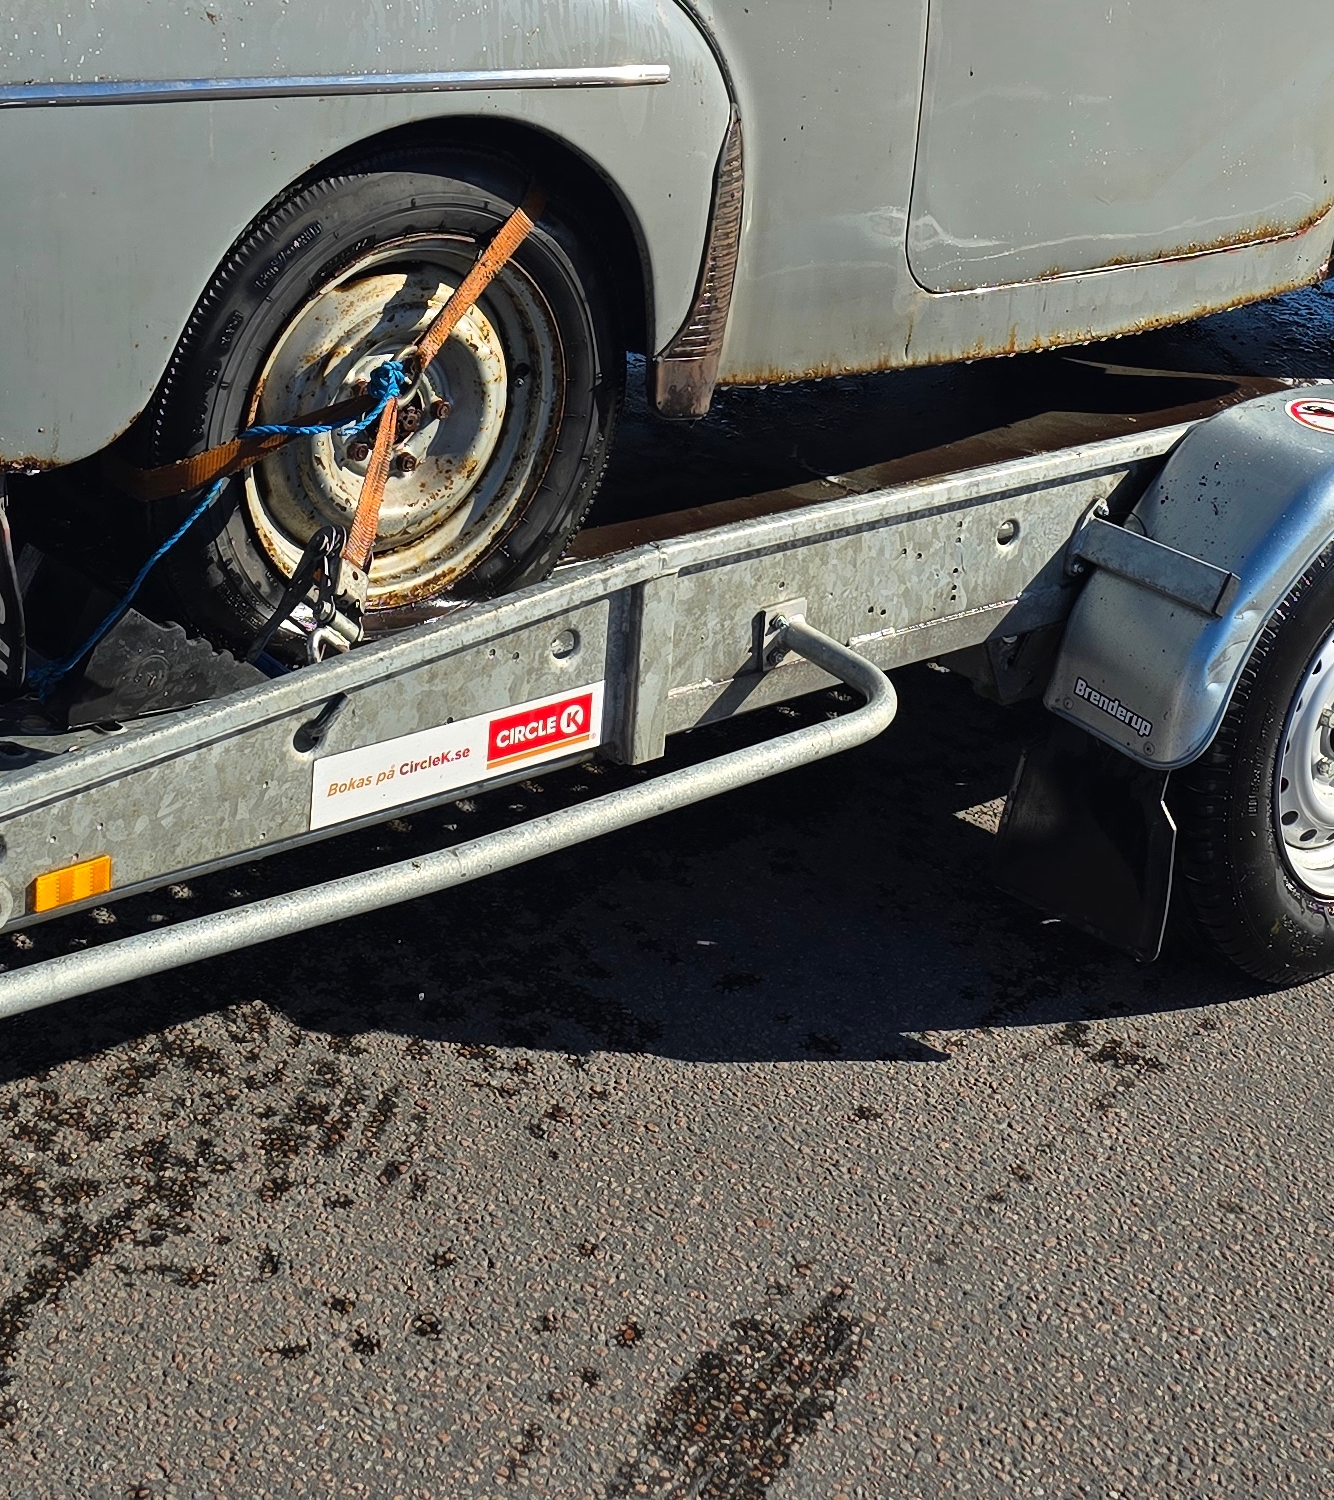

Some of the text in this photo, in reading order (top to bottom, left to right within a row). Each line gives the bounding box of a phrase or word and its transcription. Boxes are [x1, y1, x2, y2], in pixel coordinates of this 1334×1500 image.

[495, 714, 557, 748] CIRCLE
[1074, 678, 1152, 736] Brenderup
[327, 746, 471, 798] Bokas på CircleK.se
